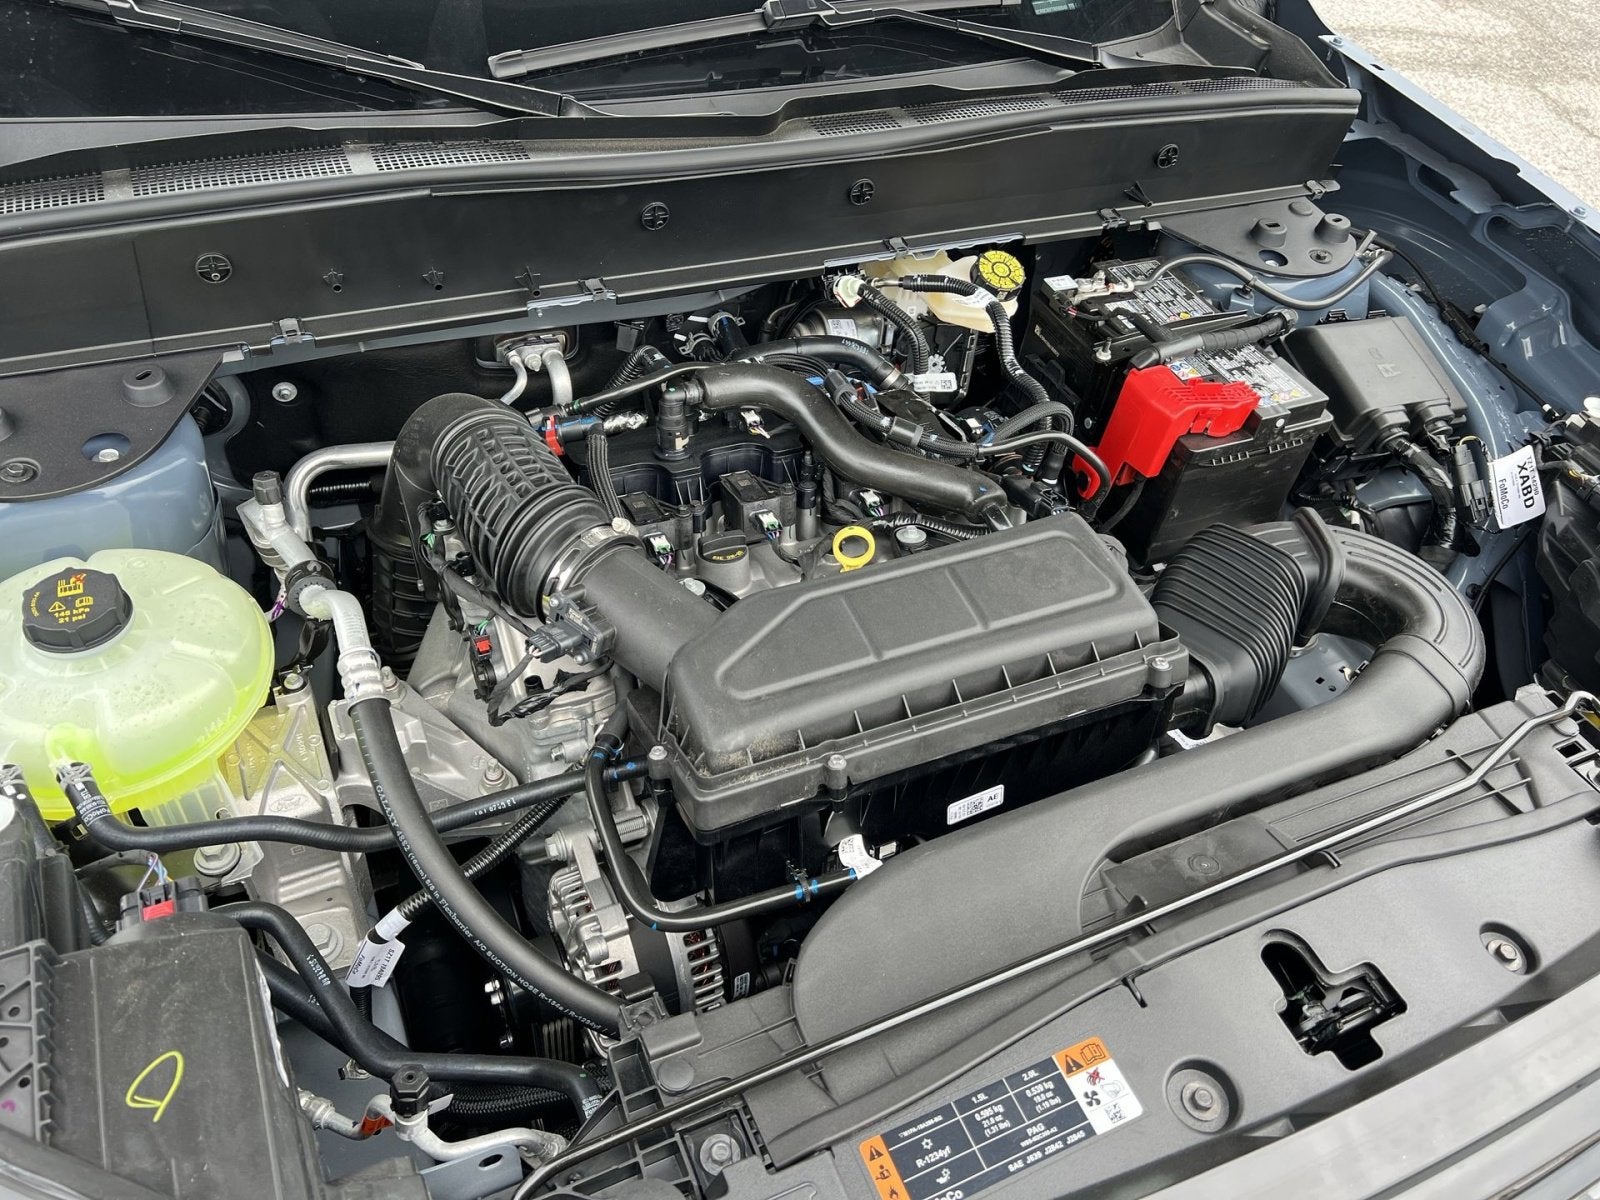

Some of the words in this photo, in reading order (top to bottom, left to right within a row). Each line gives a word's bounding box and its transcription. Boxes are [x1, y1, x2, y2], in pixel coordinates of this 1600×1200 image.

[1517, 461, 1535, 509] XABD
[1498, 478, 1510, 510] FoMoCo
[987, 792, 999, 803] AE
[375, 784, 400, 829] GALAXY
[408, 852, 427, 880] (16mm)
[438, 898, 474, 938] Flexbarrier
[474, 939, 487, 952] A/C
[486, 949, 519, 979] SUCTION
[516, 976, 539, 995] HOSE
[1042, 1080, 1055, 1090] kg
[992, 1104, 1005, 1114] kg
[1026, 1122, 1046, 1137] PAG
[915, 1145, 952, 1168] R-1234yf
[1007, 1159, 1025, 1172] SAE
